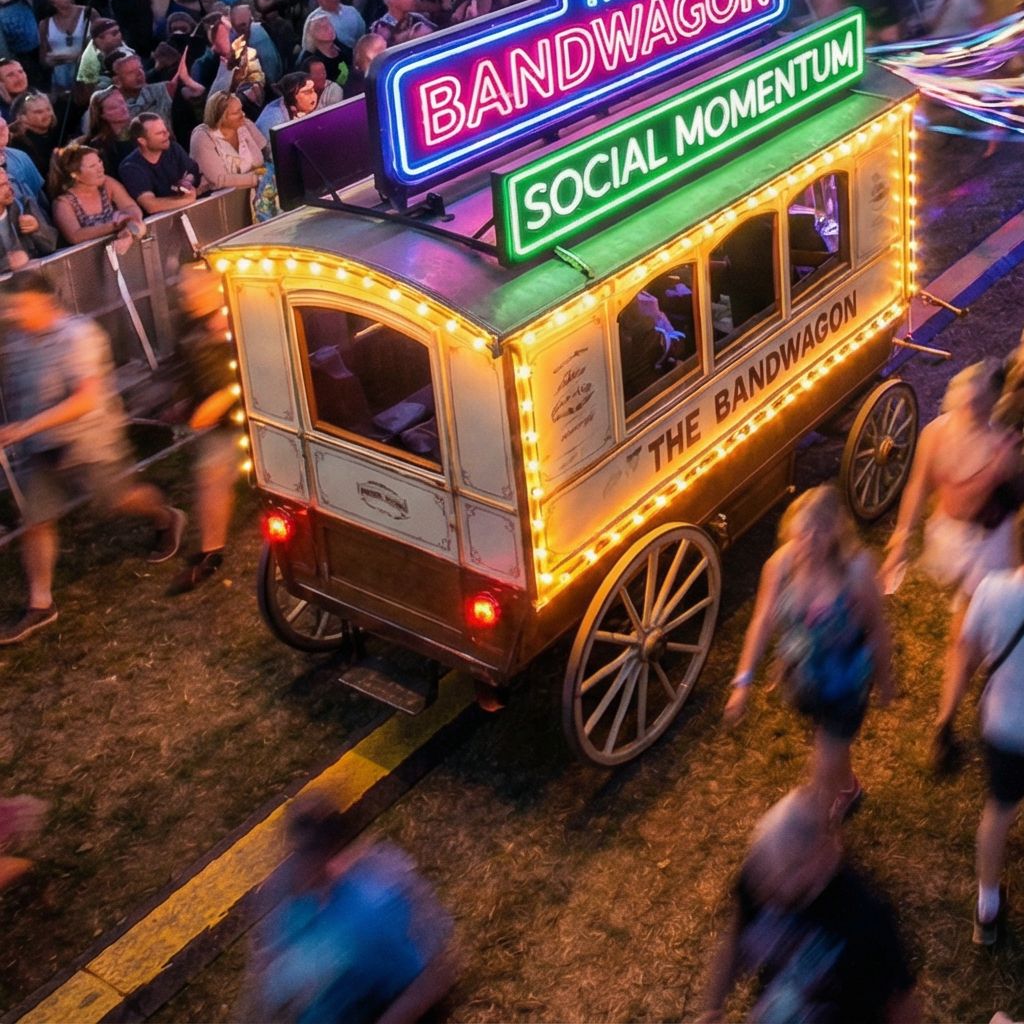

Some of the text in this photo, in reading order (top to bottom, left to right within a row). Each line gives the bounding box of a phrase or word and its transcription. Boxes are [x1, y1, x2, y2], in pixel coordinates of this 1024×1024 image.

[524, 30, 854, 230] SOCIAL MOMENTUM
[648, 408, 702, 473] THE
[714, 290, 857, 424] BANDWAGON
